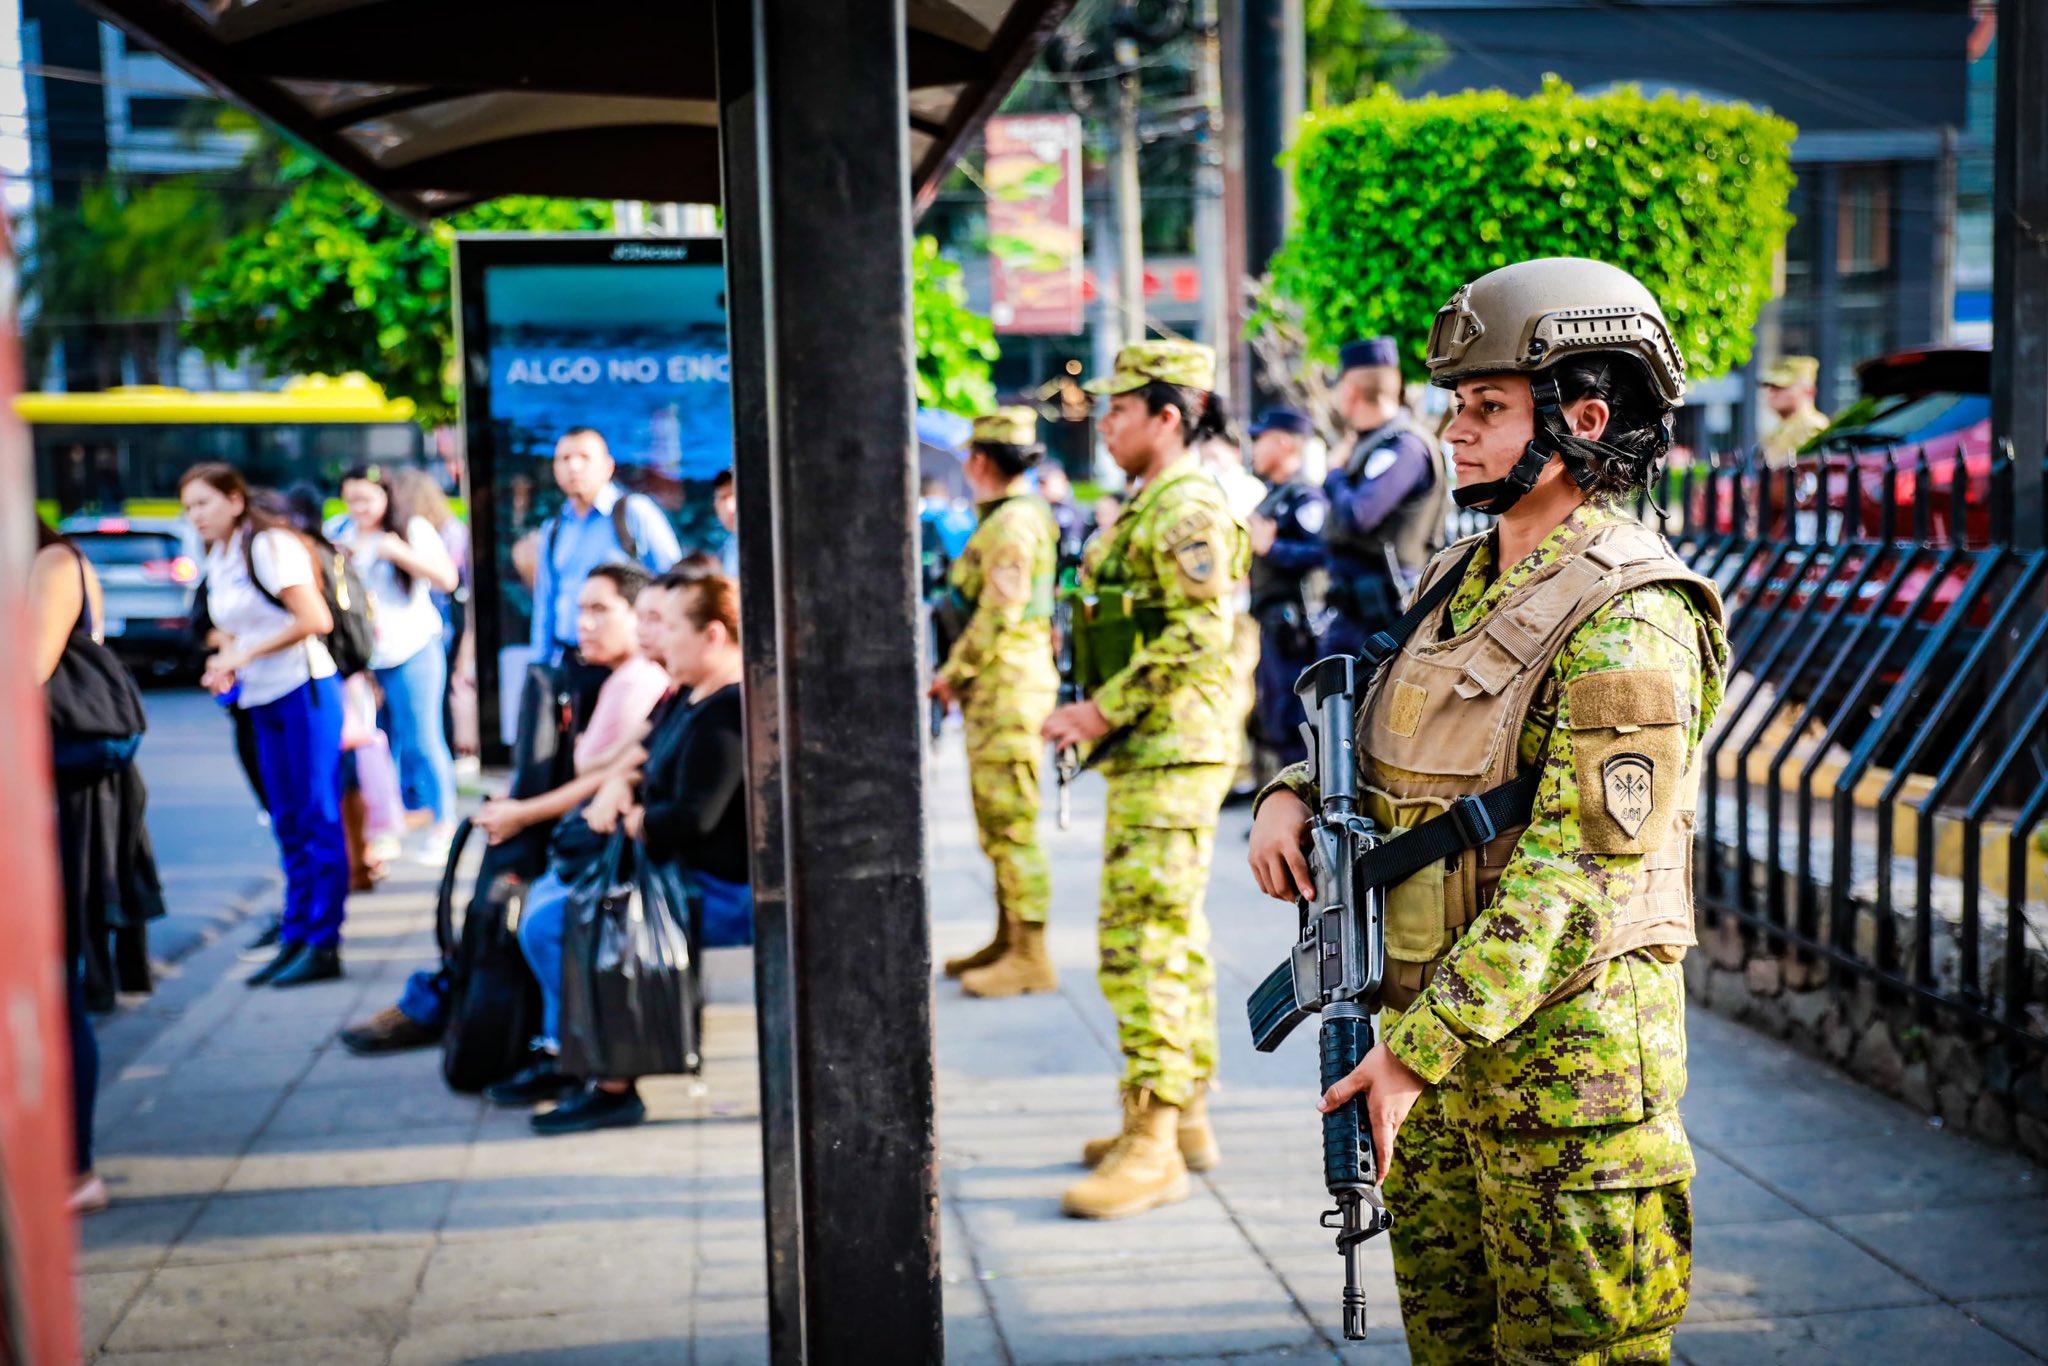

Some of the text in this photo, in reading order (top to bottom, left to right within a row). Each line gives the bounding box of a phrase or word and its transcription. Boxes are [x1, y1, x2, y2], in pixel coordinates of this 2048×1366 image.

[507, 356, 600, 384] ALGO
[608, 356, 659, 383] NO
[1621, 807, 1641, 821] 401
